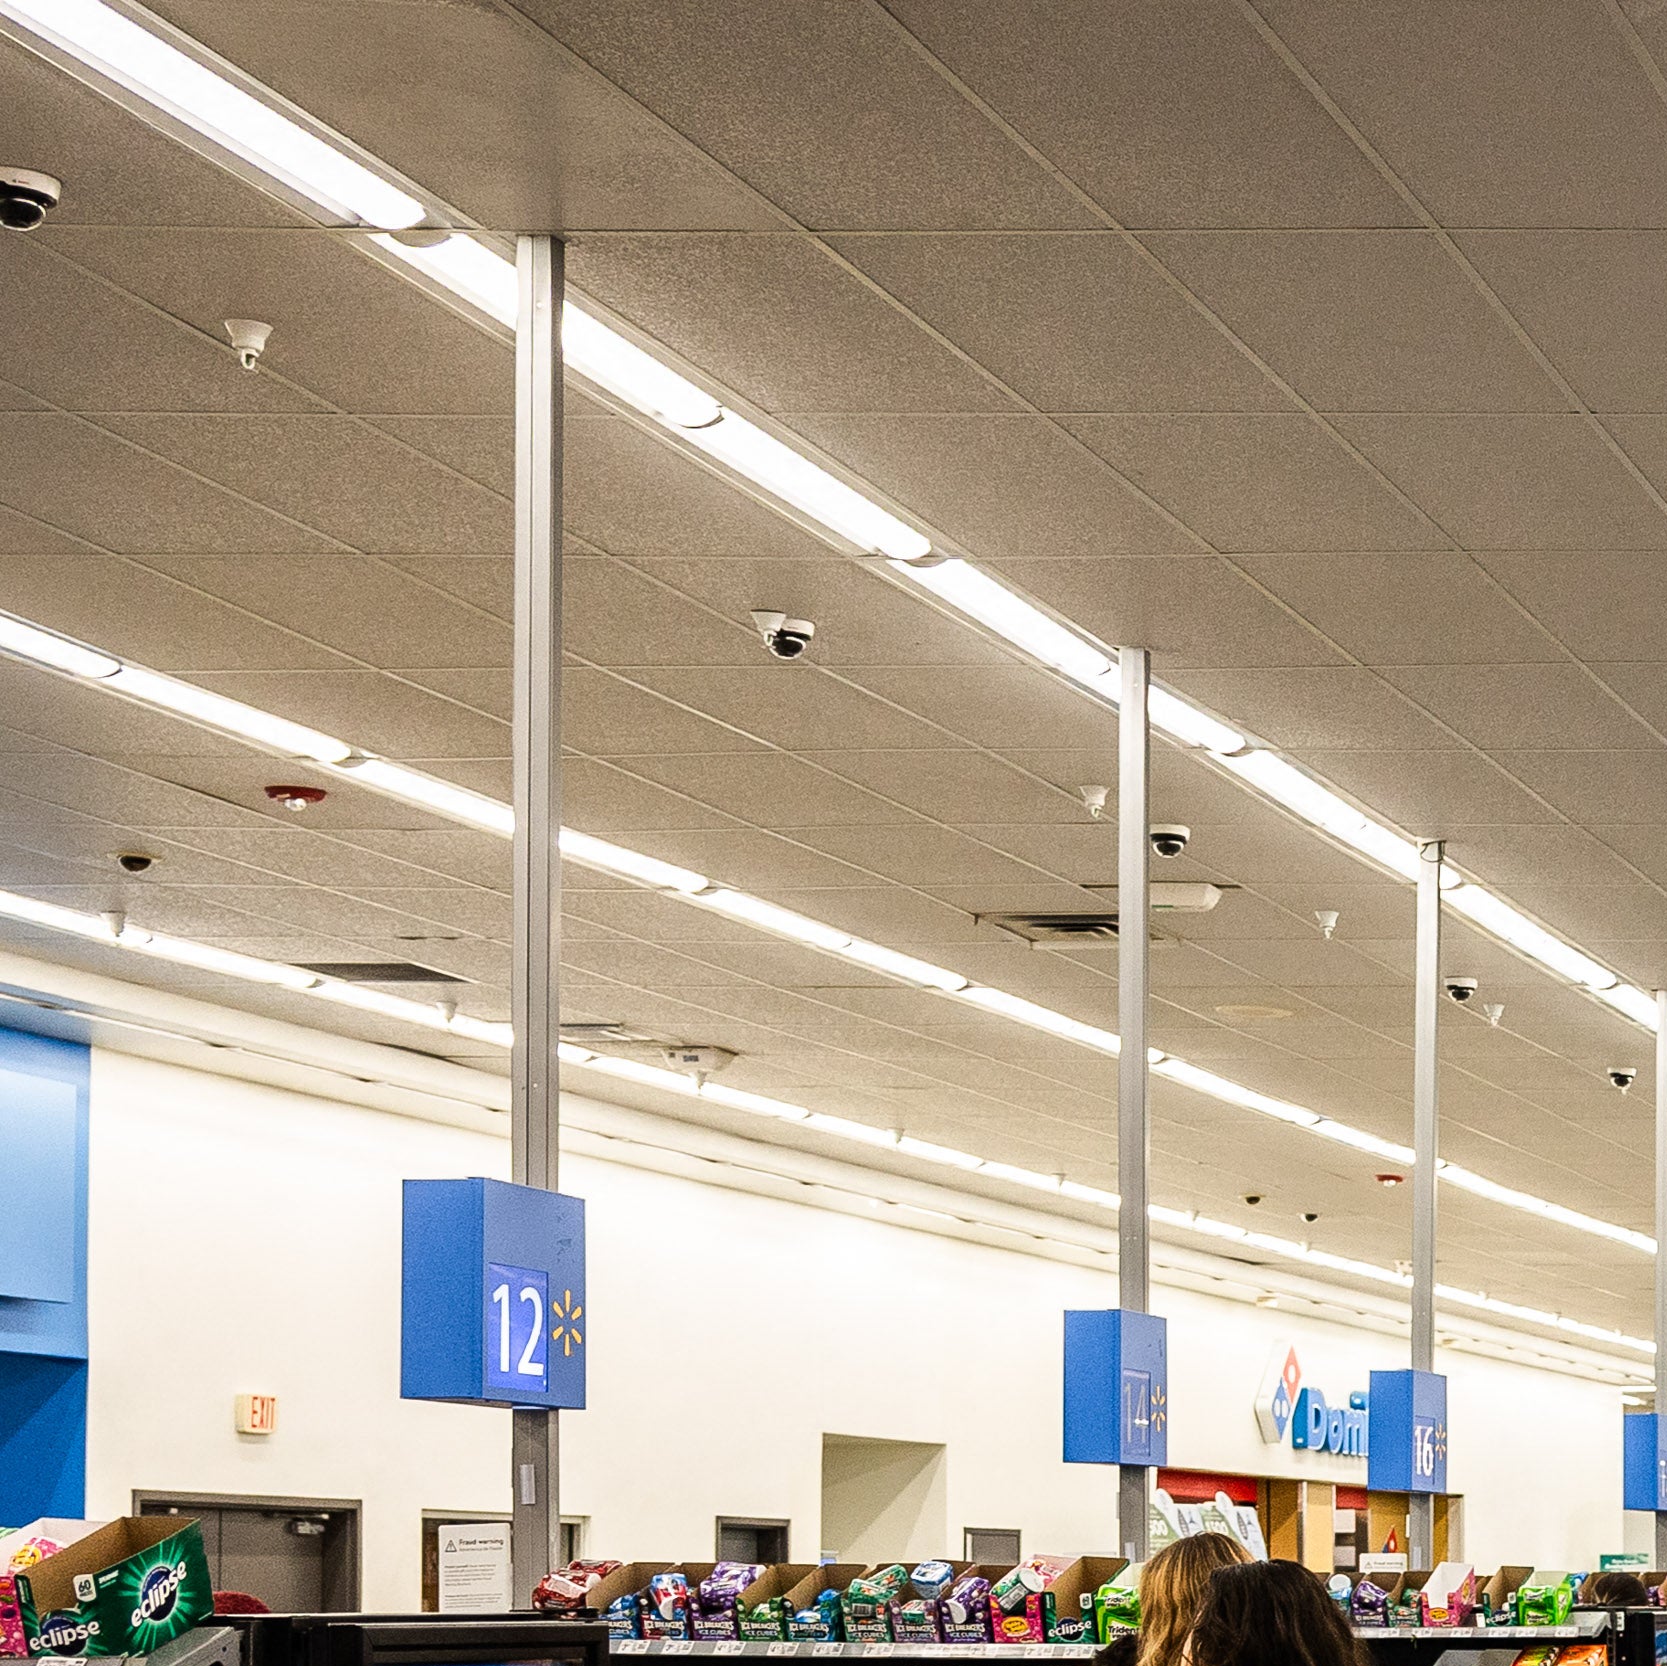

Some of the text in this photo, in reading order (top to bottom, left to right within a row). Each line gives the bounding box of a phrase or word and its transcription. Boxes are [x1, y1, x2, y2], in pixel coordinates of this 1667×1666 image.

[491, 1282, 545, 1376] 12
[251, 1396, 276, 1431] EXIT
[1125, 1382, 1149, 1443] 14
[1414, 1425, 1434, 1476] 16
[459, 1538, 504, 1546] Fraud warning
[77, 1579, 92, 1593] 60
[131, 1561, 187, 1628] eclipse
[29, 1620, 100, 1651] eclipse
[1048, 1620, 1092, 1637] eclipse
